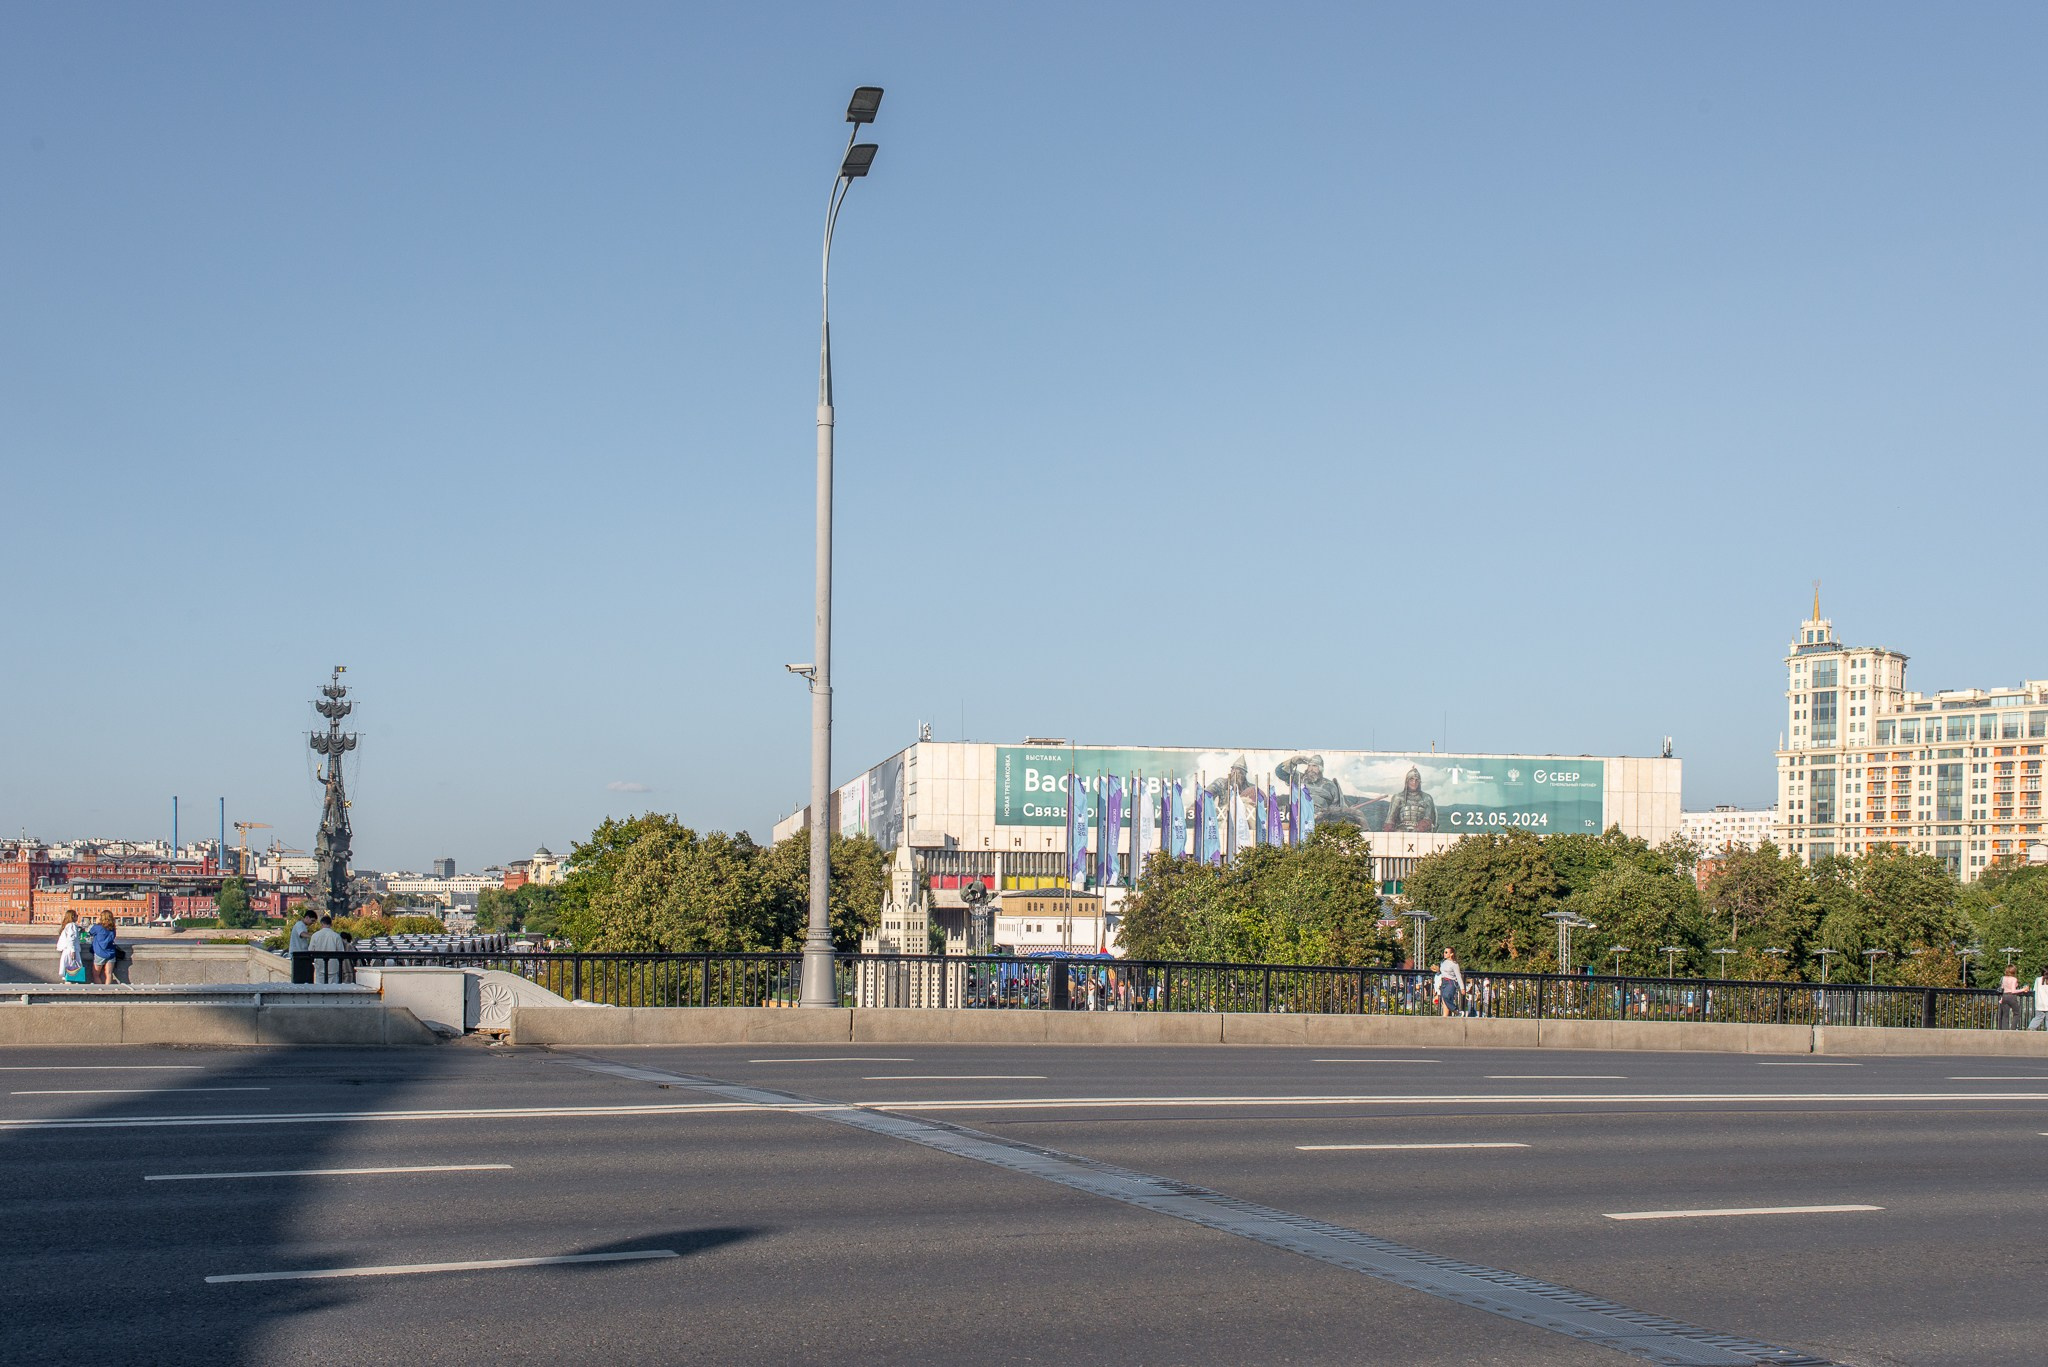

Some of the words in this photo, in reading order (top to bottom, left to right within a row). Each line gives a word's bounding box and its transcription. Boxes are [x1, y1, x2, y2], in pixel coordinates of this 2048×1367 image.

[1550, 772, 1580, 781] СБЕР
[1023, 803, 1067, 817] Связь
[1450, 812, 1462, 825] С
[1466, 812, 1548, 826] 23.05.2024
[1584, 819, 1595, 827] 12+
